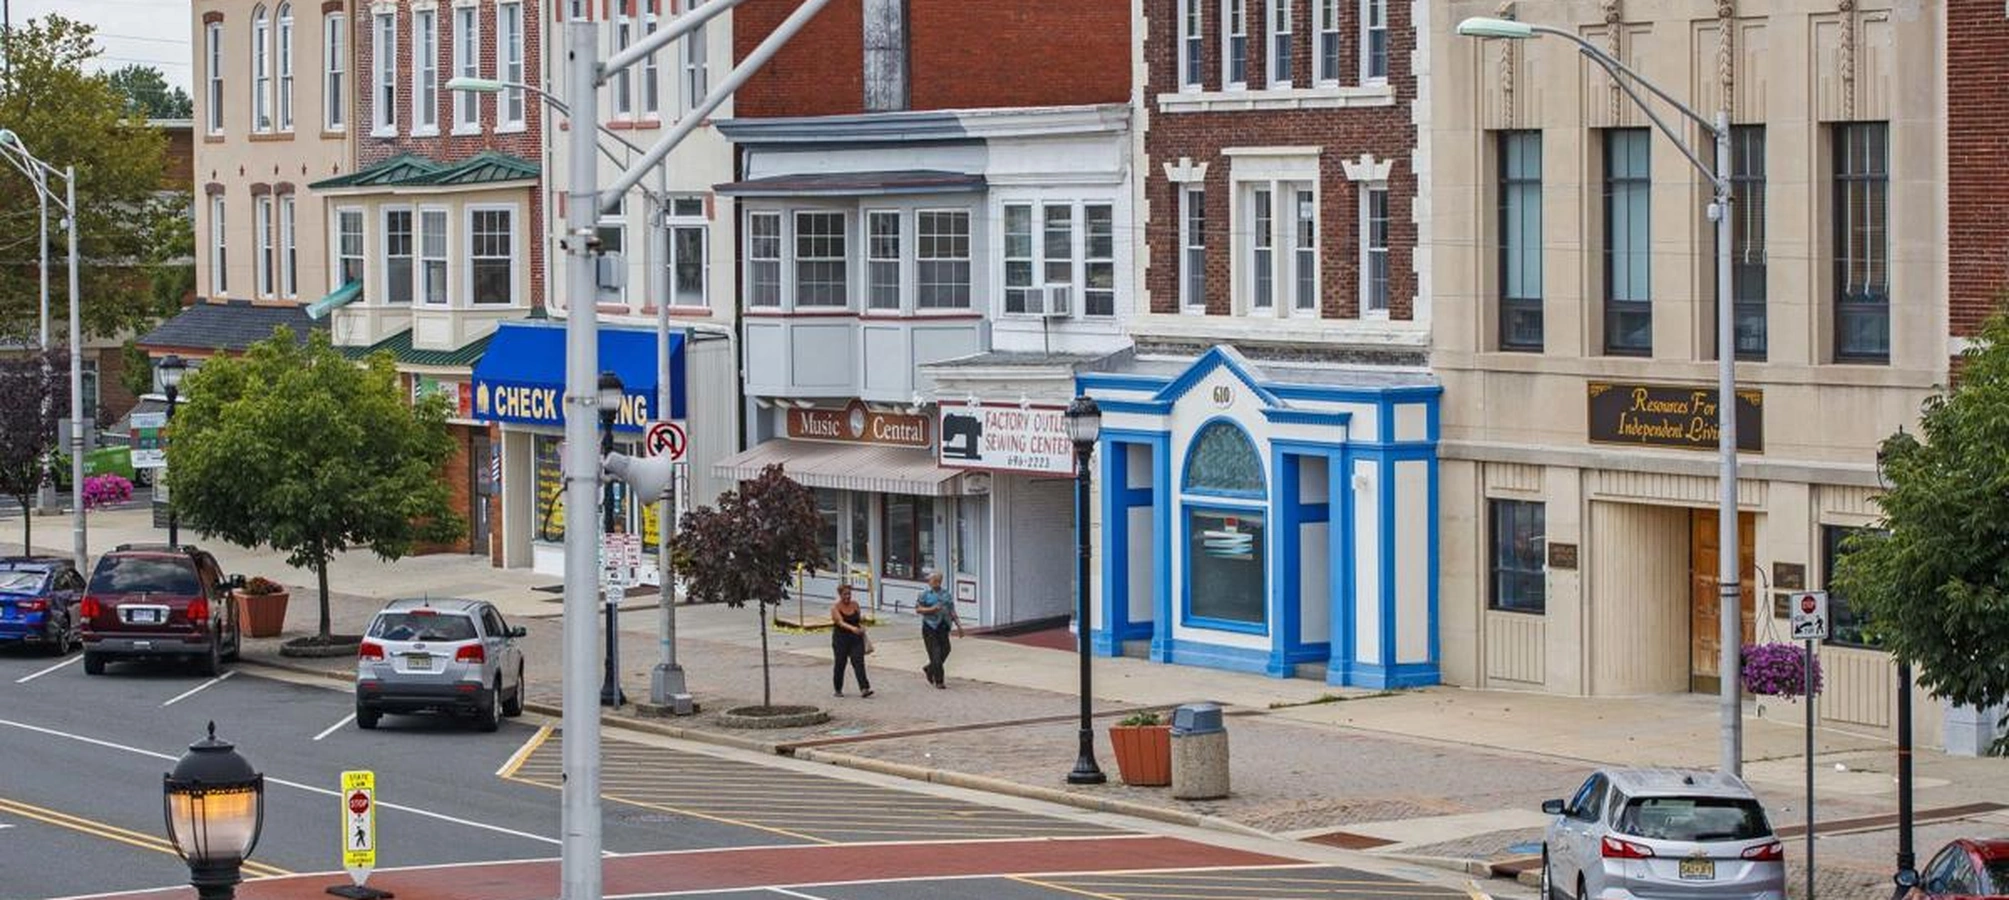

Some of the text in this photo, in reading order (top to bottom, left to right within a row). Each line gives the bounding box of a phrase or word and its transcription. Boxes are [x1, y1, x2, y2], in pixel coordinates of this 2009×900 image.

[495, 385, 557, 420] CHECK
[1213, 385, 1230, 403] 610
[1631, 388, 1717, 416] Resources For
[800, 411, 924, 442] Music Central
[985, 411, 1069, 434] FACTORY OUTLE
[1618, 412, 1720, 442] Independent Livi
[985, 433, 1071, 455] SEWING CENTER
[350, 799, 368, 809] STOP
